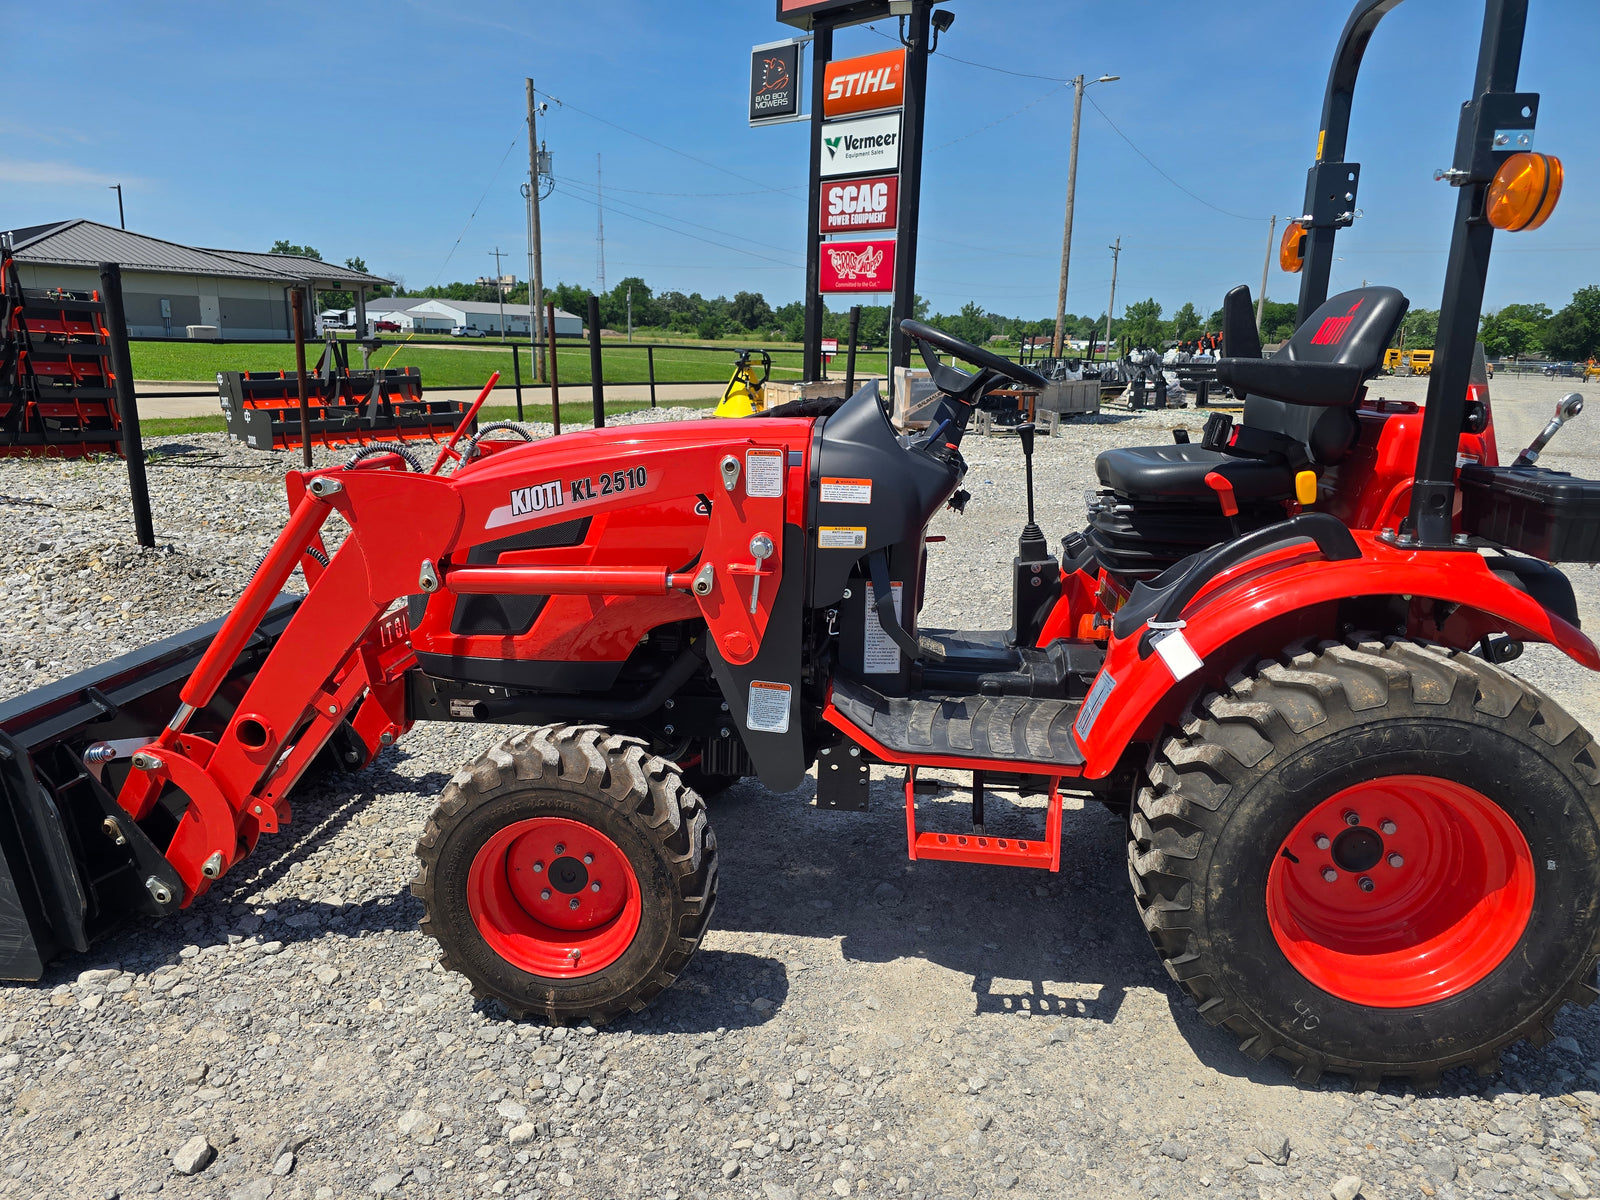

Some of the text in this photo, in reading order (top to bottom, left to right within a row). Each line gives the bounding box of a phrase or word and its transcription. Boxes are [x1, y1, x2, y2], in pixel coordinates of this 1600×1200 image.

[827, 67, 896, 101] STIHL
[755, 91, 788, 103] BAD BOY
[755, 98, 789, 109] MOWERS
[843, 132, 897, 151] Vermeer
[845, 151, 870, 159] Equipment
[828, 182, 888, 215] SCAG
[828, 211, 887, 226] POWER EQUIPMENT
[510, 466, 648, 517] KIOTI KL 2510
